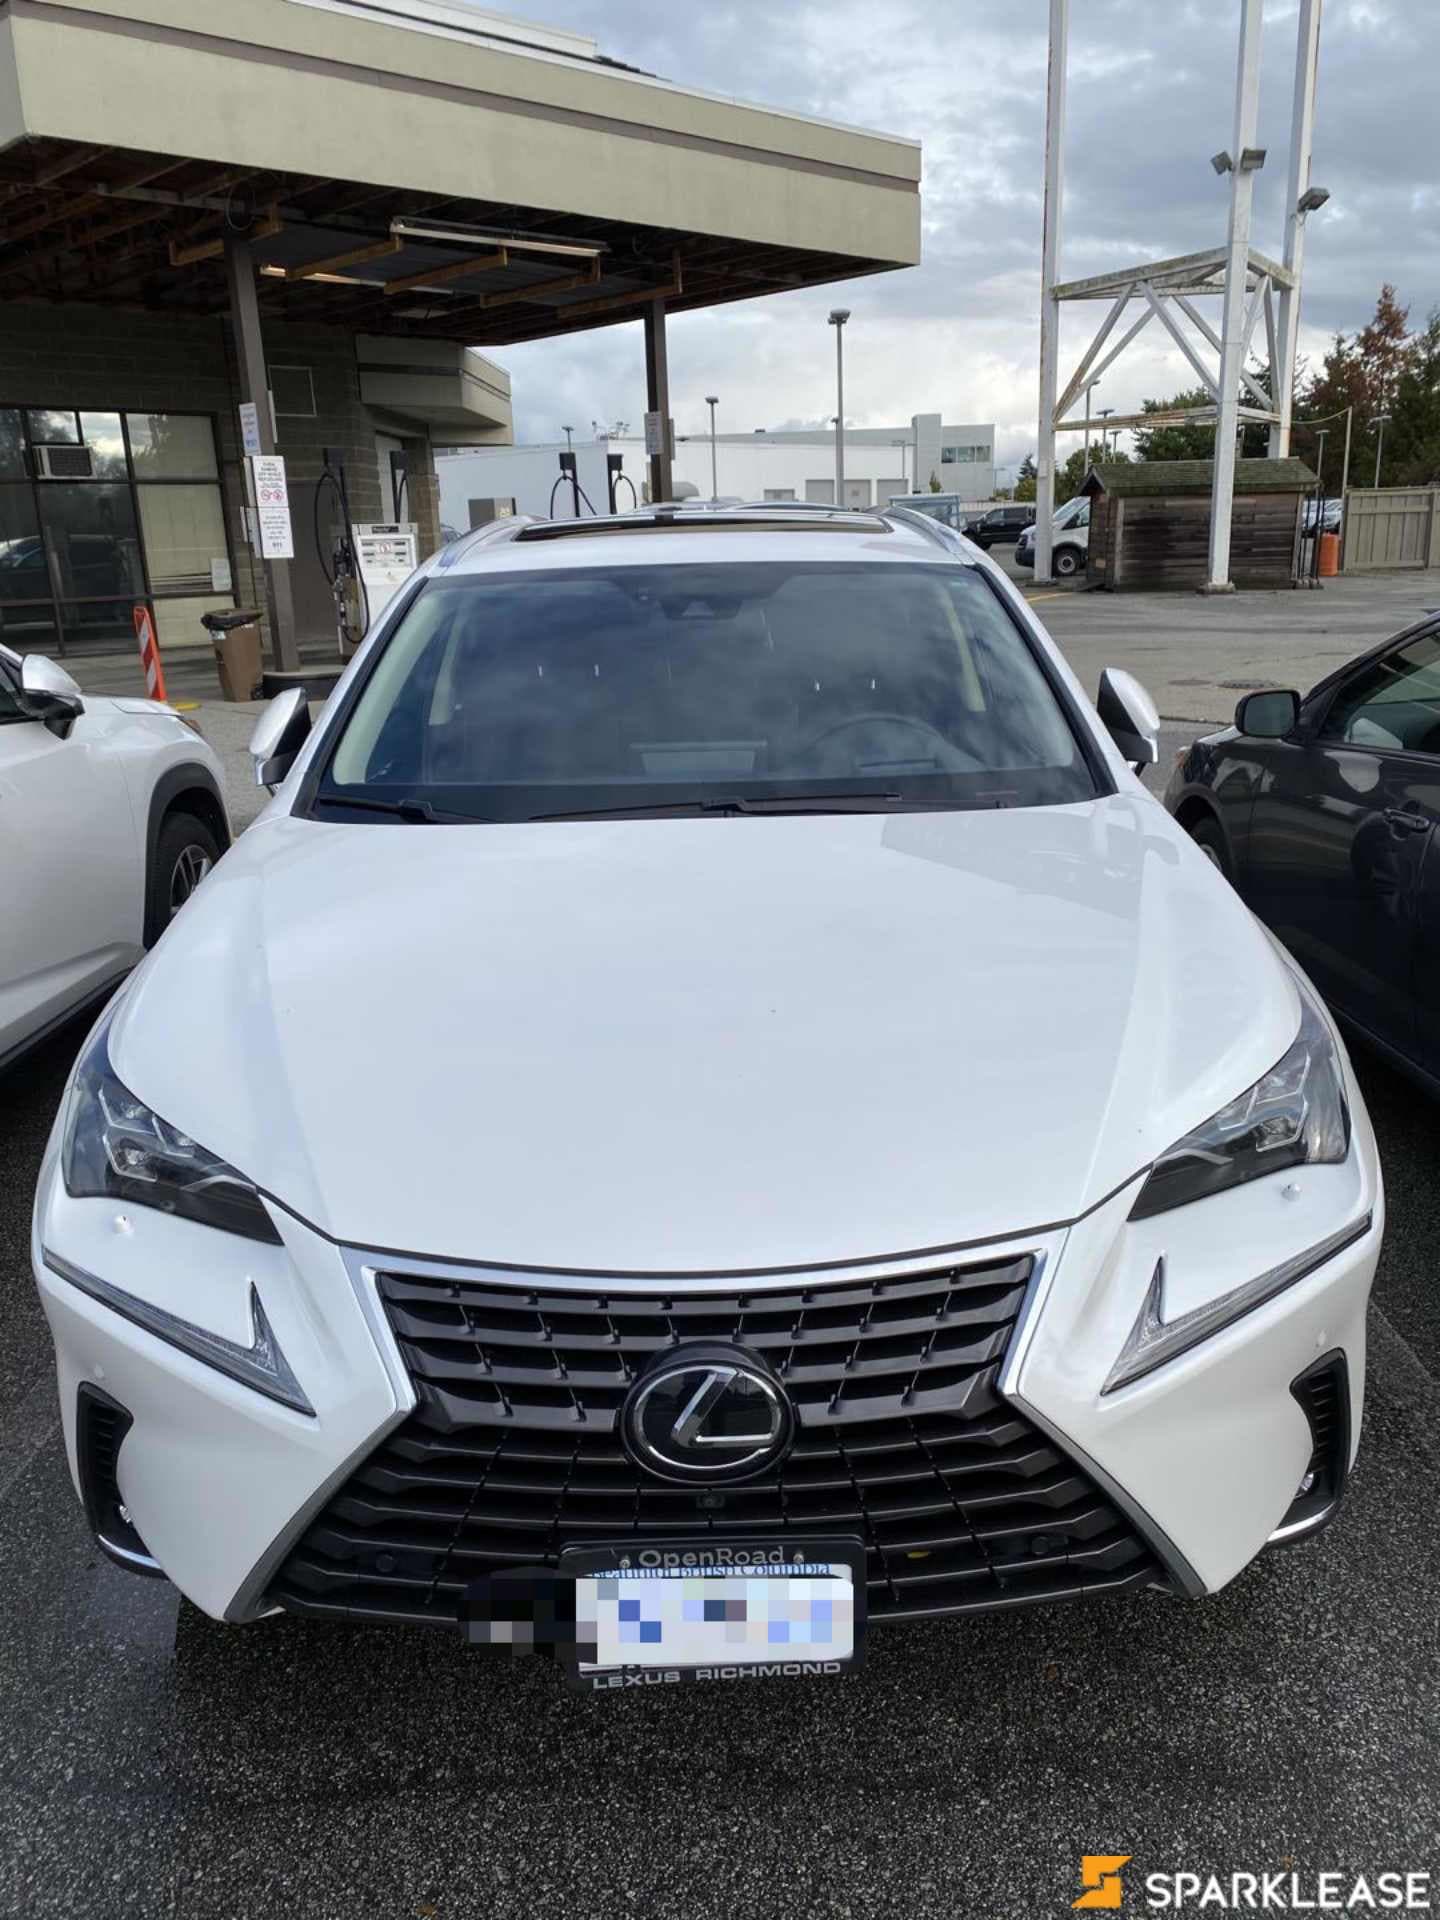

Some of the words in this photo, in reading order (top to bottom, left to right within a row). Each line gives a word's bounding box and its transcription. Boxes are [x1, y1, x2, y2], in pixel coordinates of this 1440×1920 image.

[638, 1546, 785, 1569] OpenRoad
[593, 1671, 681, 1689] LEXUS
[696, 1662, 841, 1681] RICHMOND
